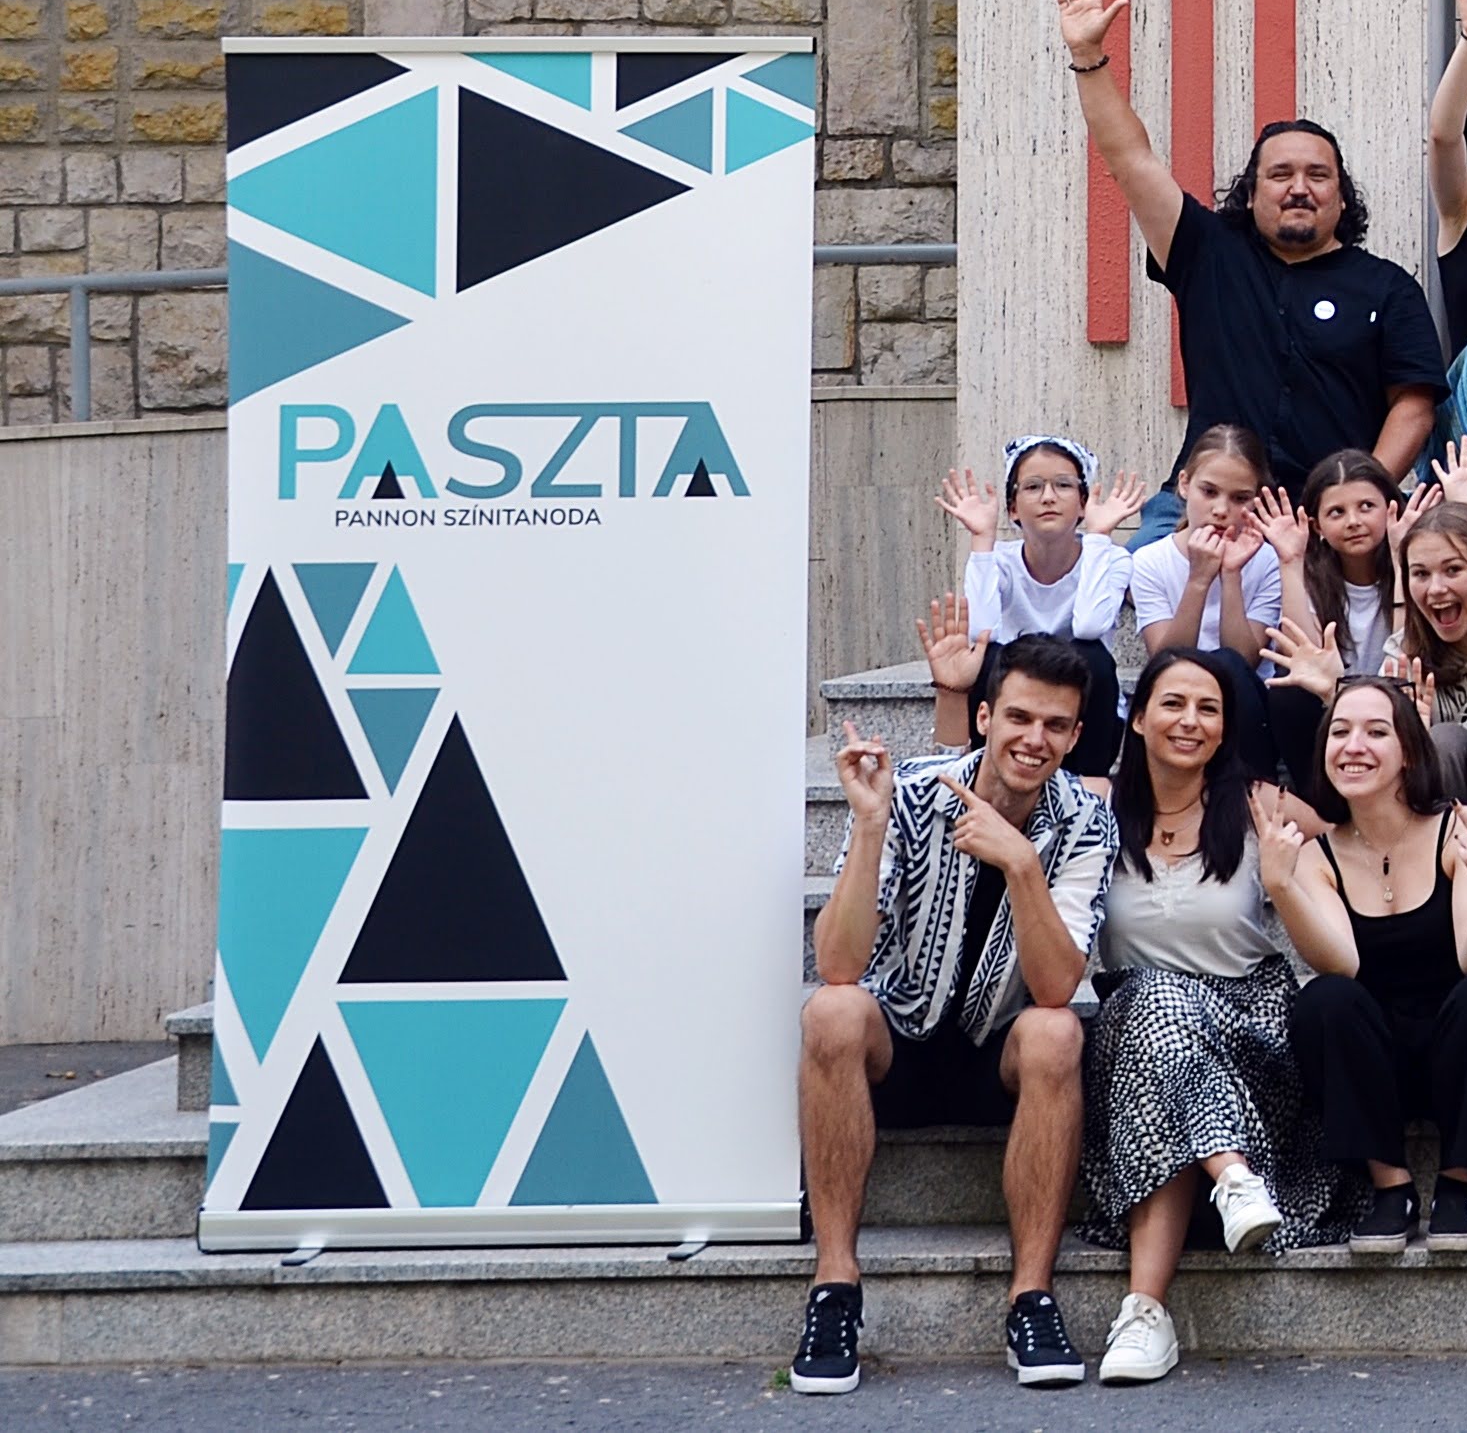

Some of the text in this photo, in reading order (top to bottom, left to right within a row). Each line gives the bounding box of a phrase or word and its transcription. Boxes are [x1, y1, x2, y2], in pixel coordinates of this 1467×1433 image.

[277, 402, 751, 500] PASZTA
[335, 502, 602, 527] PANNON SZÍNITANODA
